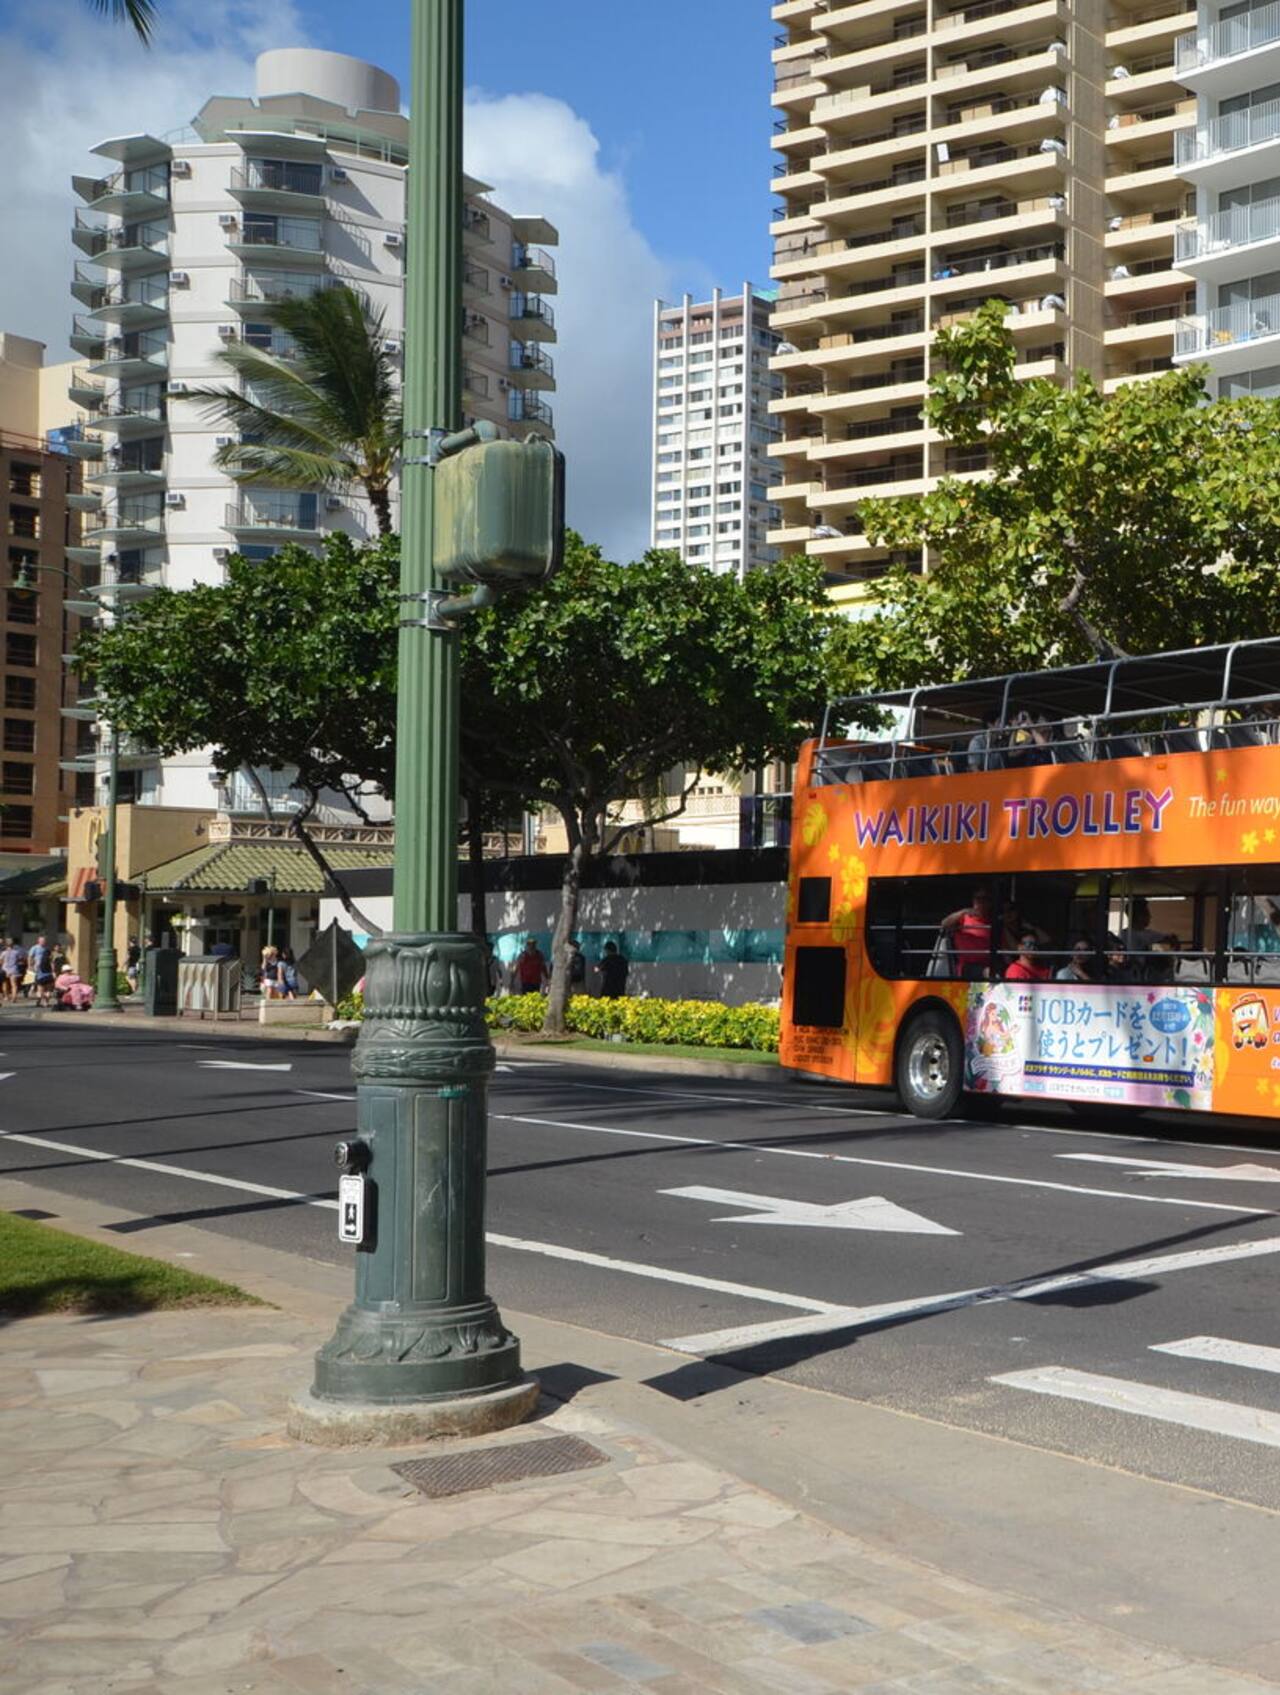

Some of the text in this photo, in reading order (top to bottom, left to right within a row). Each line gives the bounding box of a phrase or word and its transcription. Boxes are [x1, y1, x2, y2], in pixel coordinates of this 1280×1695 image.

[854, 786, 1174, 850] WAIKIKI TROLLEY
[1189, 796, 1216, 817] The
[1219, 793, 1246, 816] fun
[1037, 998, 1147, 1031] JCBカードを
